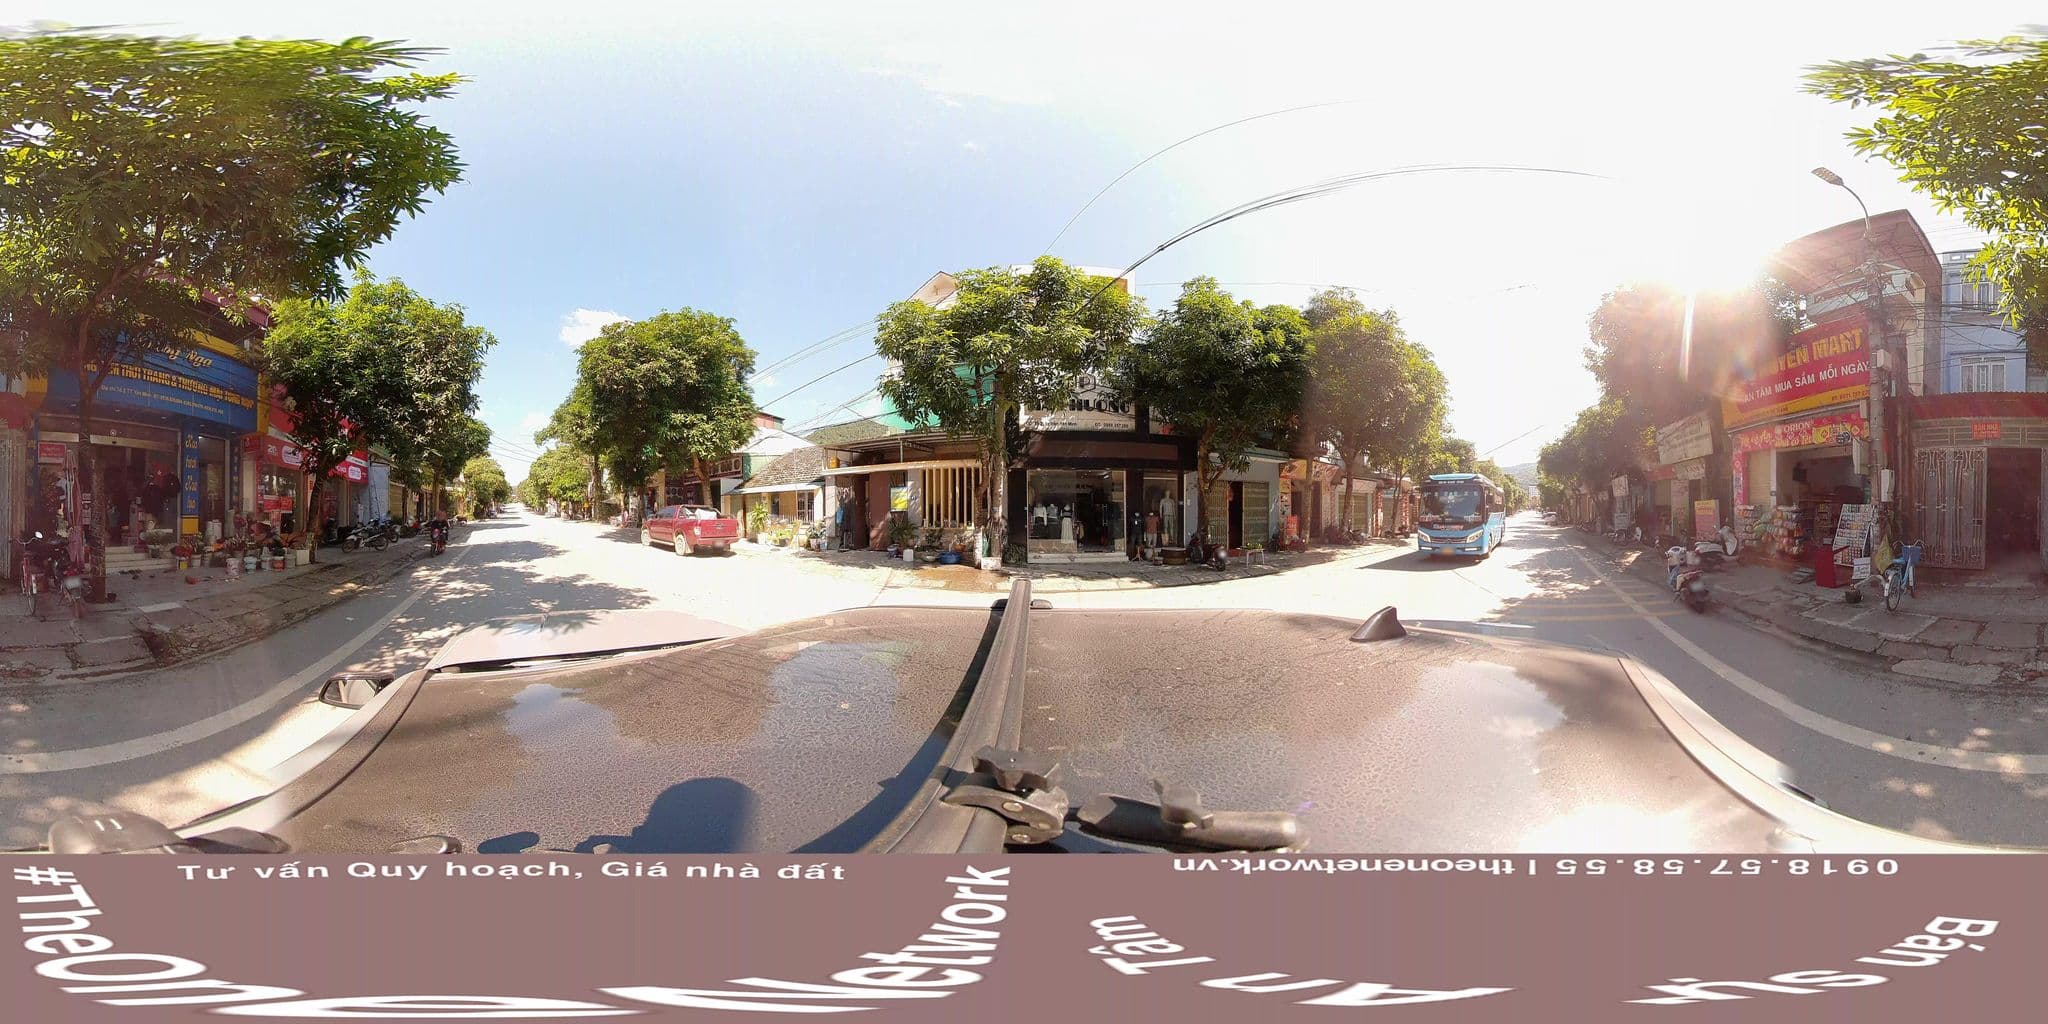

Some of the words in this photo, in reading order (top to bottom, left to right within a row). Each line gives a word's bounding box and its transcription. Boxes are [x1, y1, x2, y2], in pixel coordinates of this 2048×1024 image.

[1812, 328, 1864, 361] MART
[1755, 385, 1773, 399] TÂM
[1775, 380, 1793, 393] MUA
[1794, 371, 1816, 388] SẮM
[1819, 363, 1838, 381] MỖI
[1841, 359, 1870, 377] NGÀY
[1783, 421, 1811, 433] ORION
